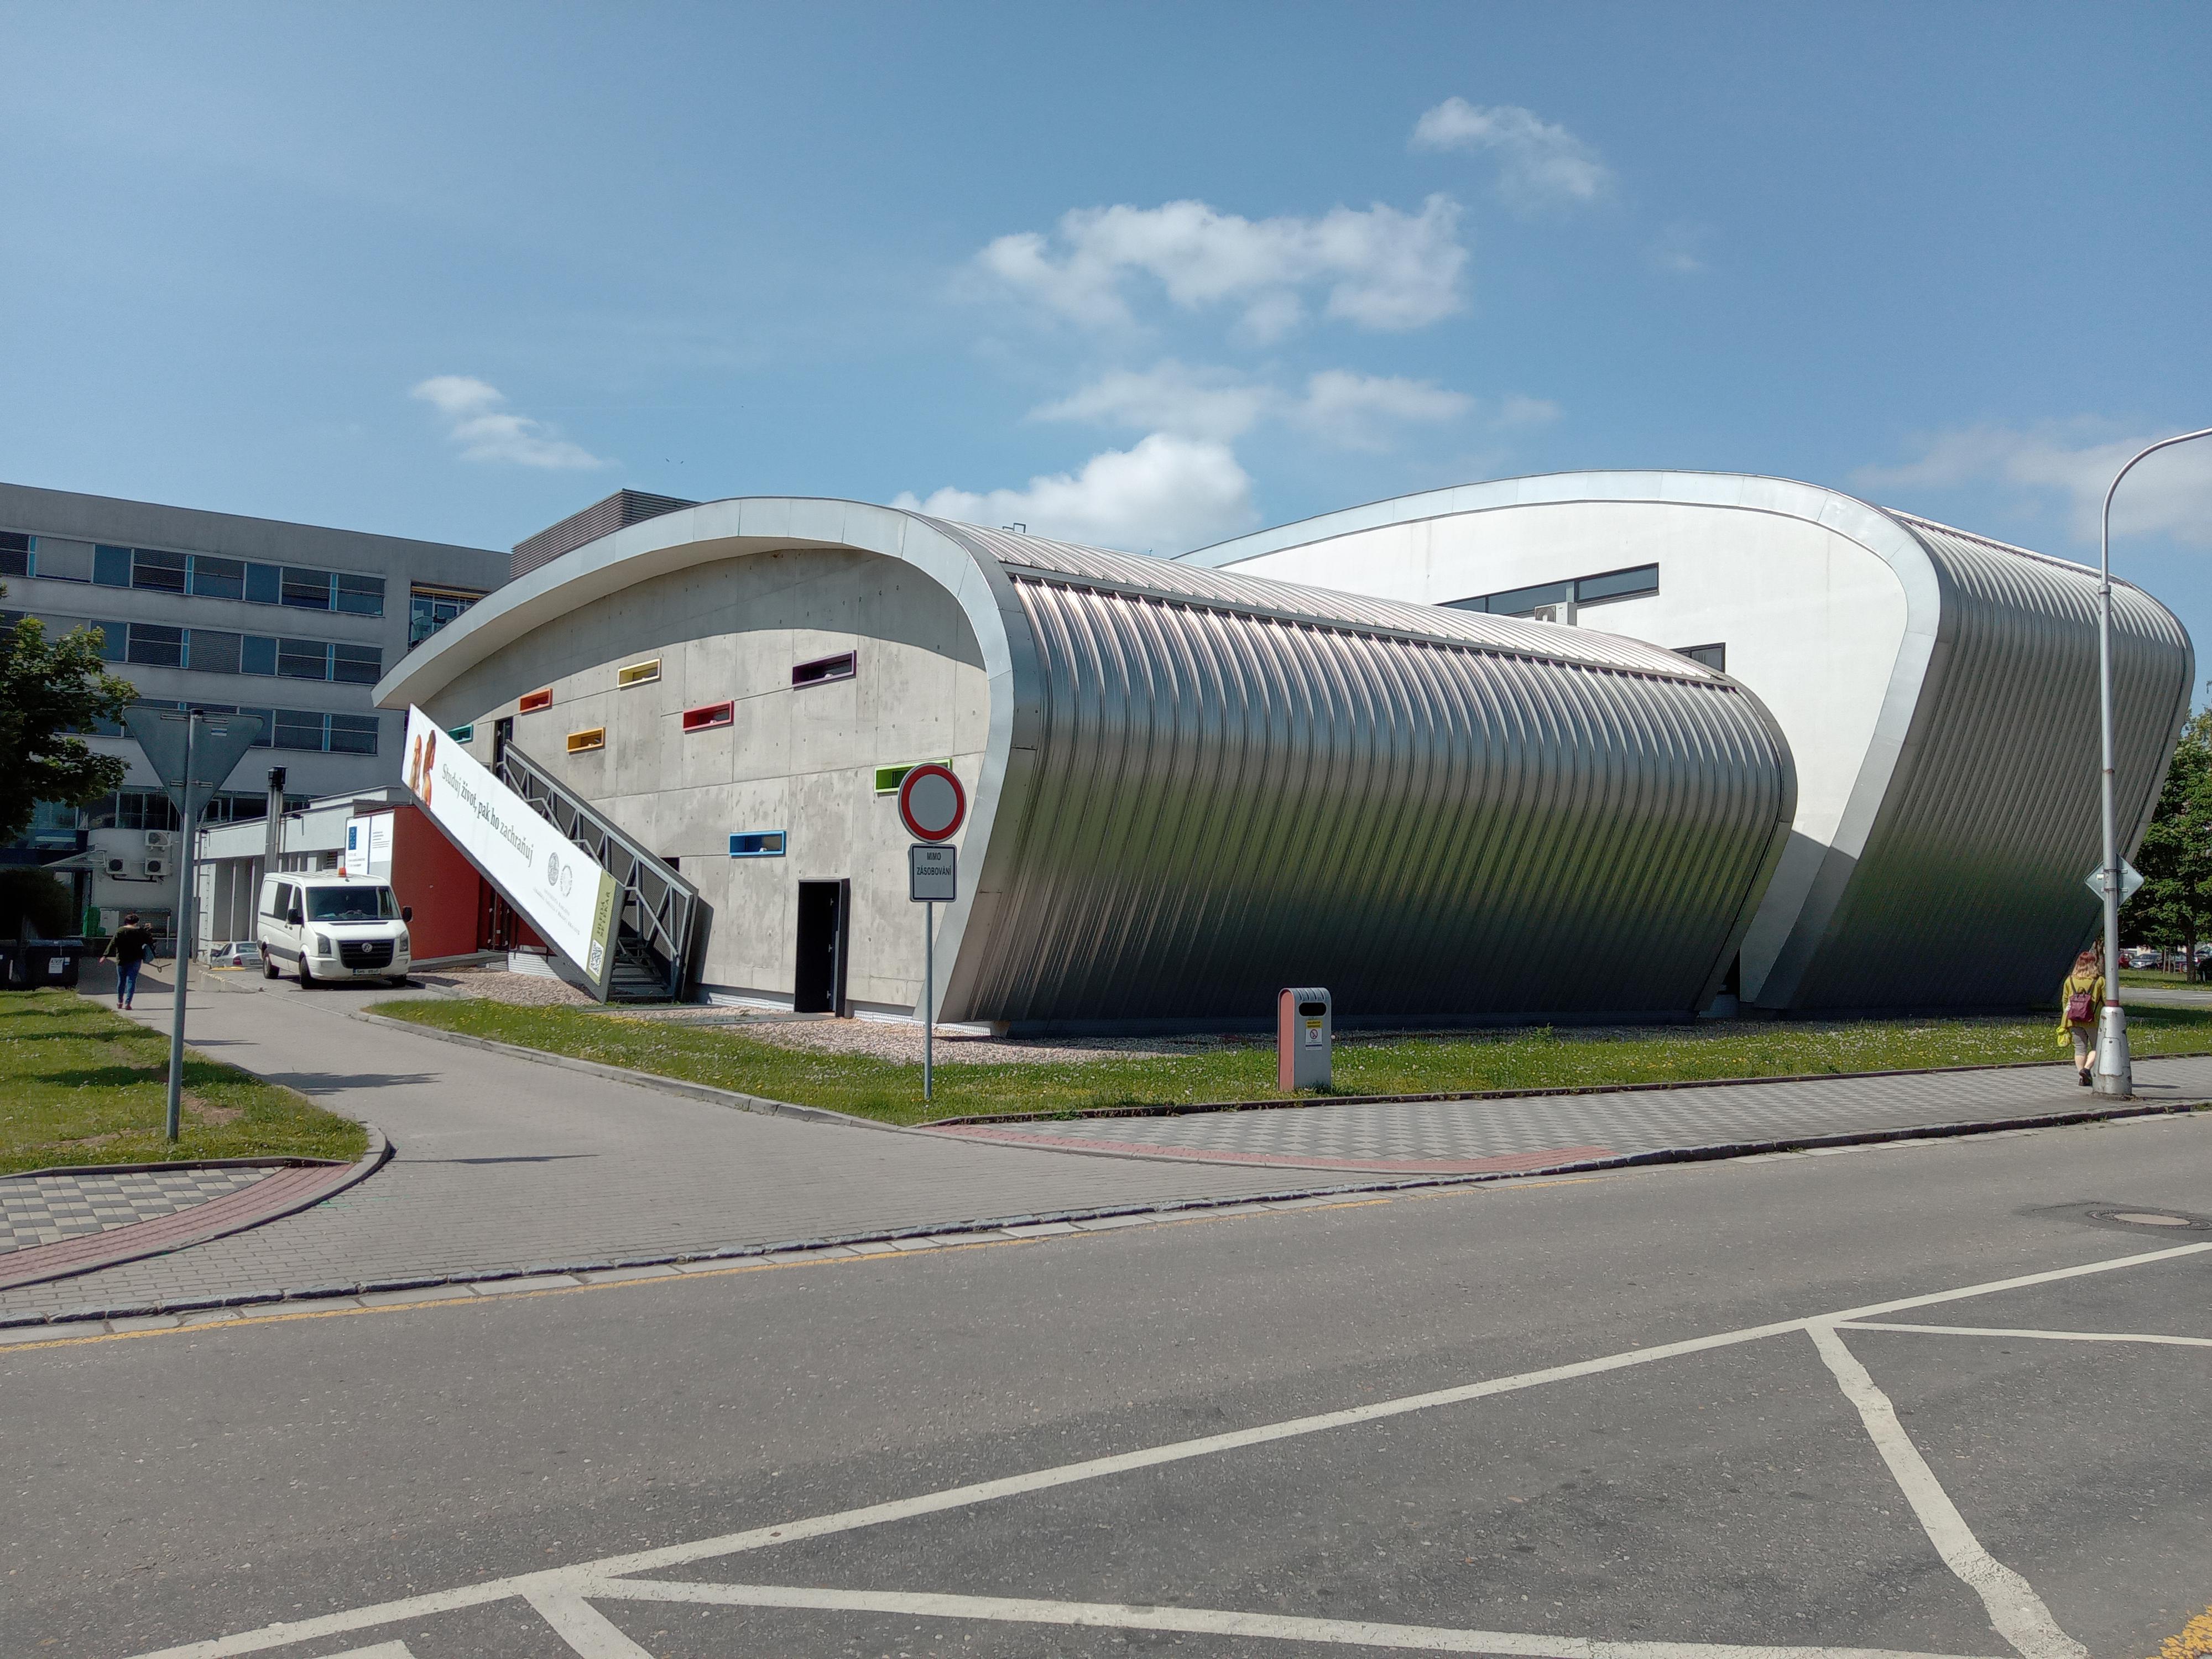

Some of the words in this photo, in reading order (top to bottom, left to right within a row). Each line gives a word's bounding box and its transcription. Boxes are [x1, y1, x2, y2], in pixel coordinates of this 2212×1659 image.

[442, 764, 462, 799] Studuj
[461, 781, 477, 812] život,
[477, 801, 489, 822] pak
[490, 807, 500, 830] ho
[499, 822, 534, 868] zachraňuj
[927, 852, 941, 860] MIMO
[916, 865, 951, 875] ZÁSOBOVÁNÍ
